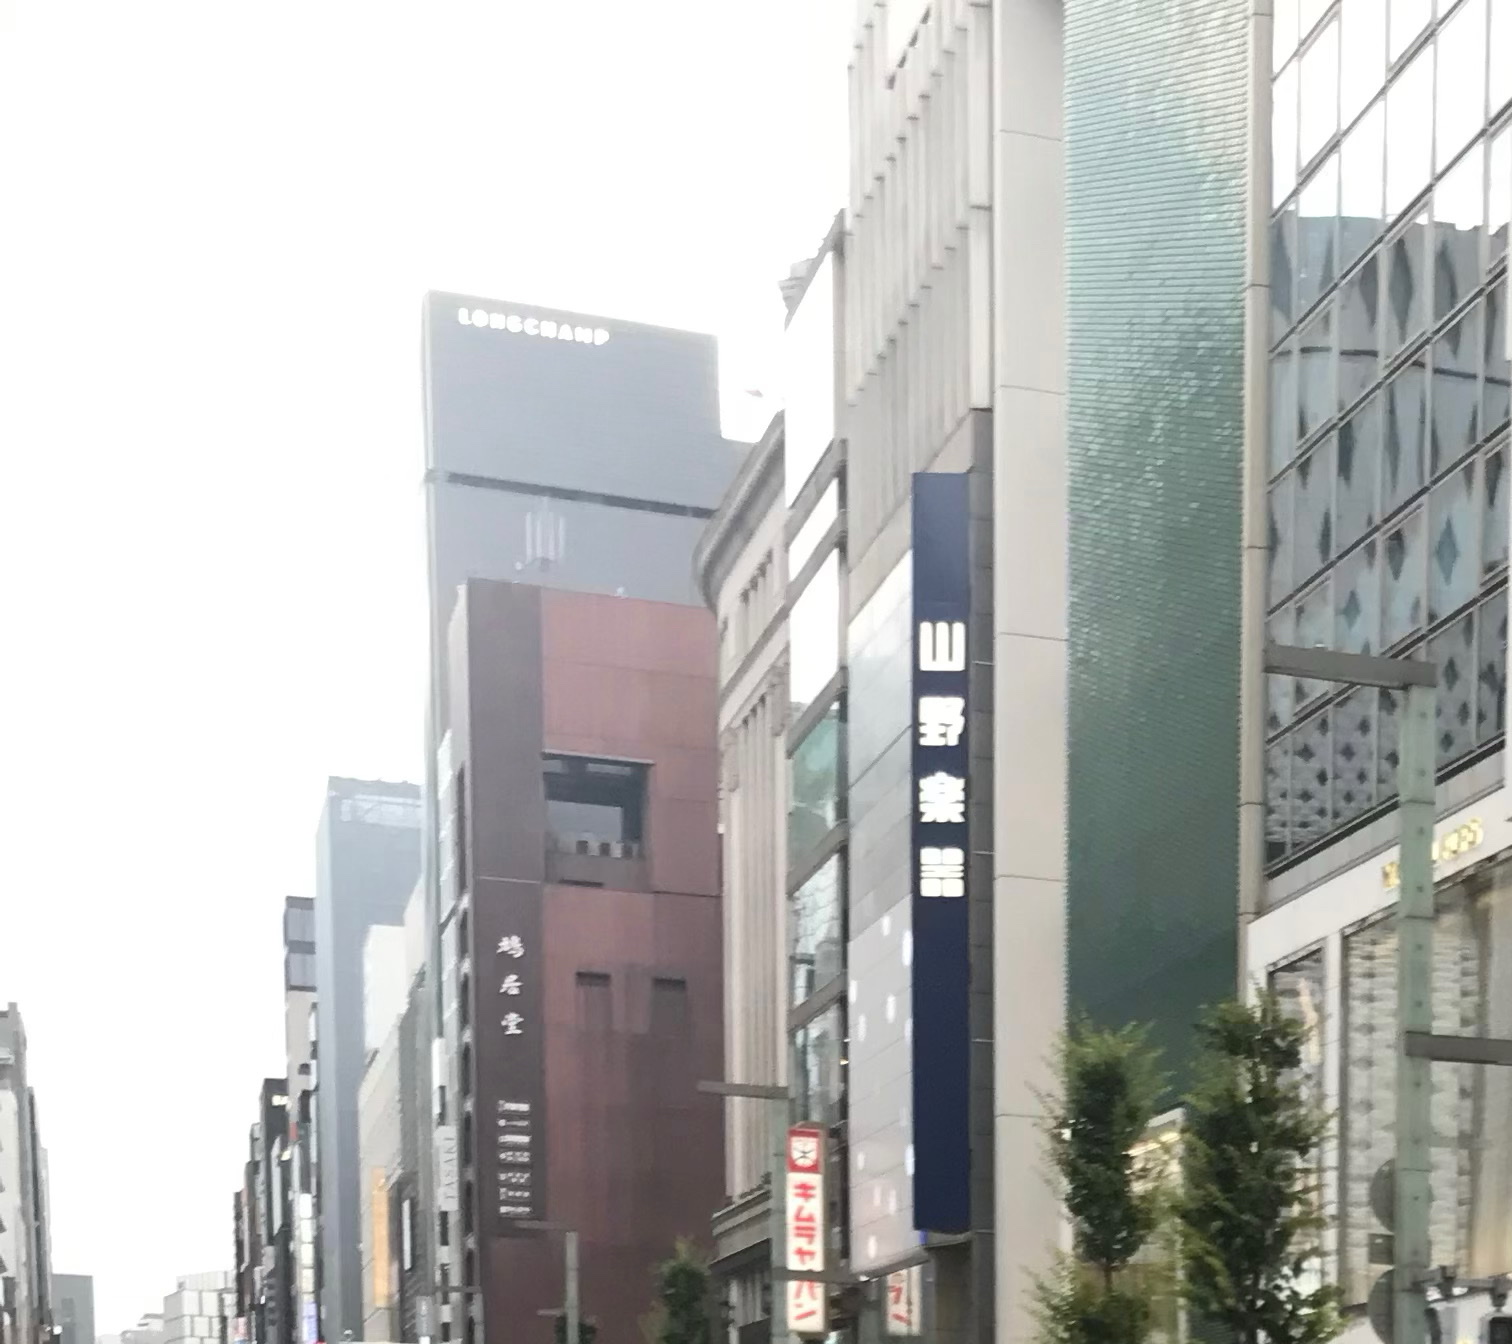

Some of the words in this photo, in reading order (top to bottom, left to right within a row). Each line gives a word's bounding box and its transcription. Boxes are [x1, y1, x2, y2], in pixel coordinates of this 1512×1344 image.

[457, 306, 610, 346] LONGCHAMP
[918, 620, 967, 898] 山野楽器
